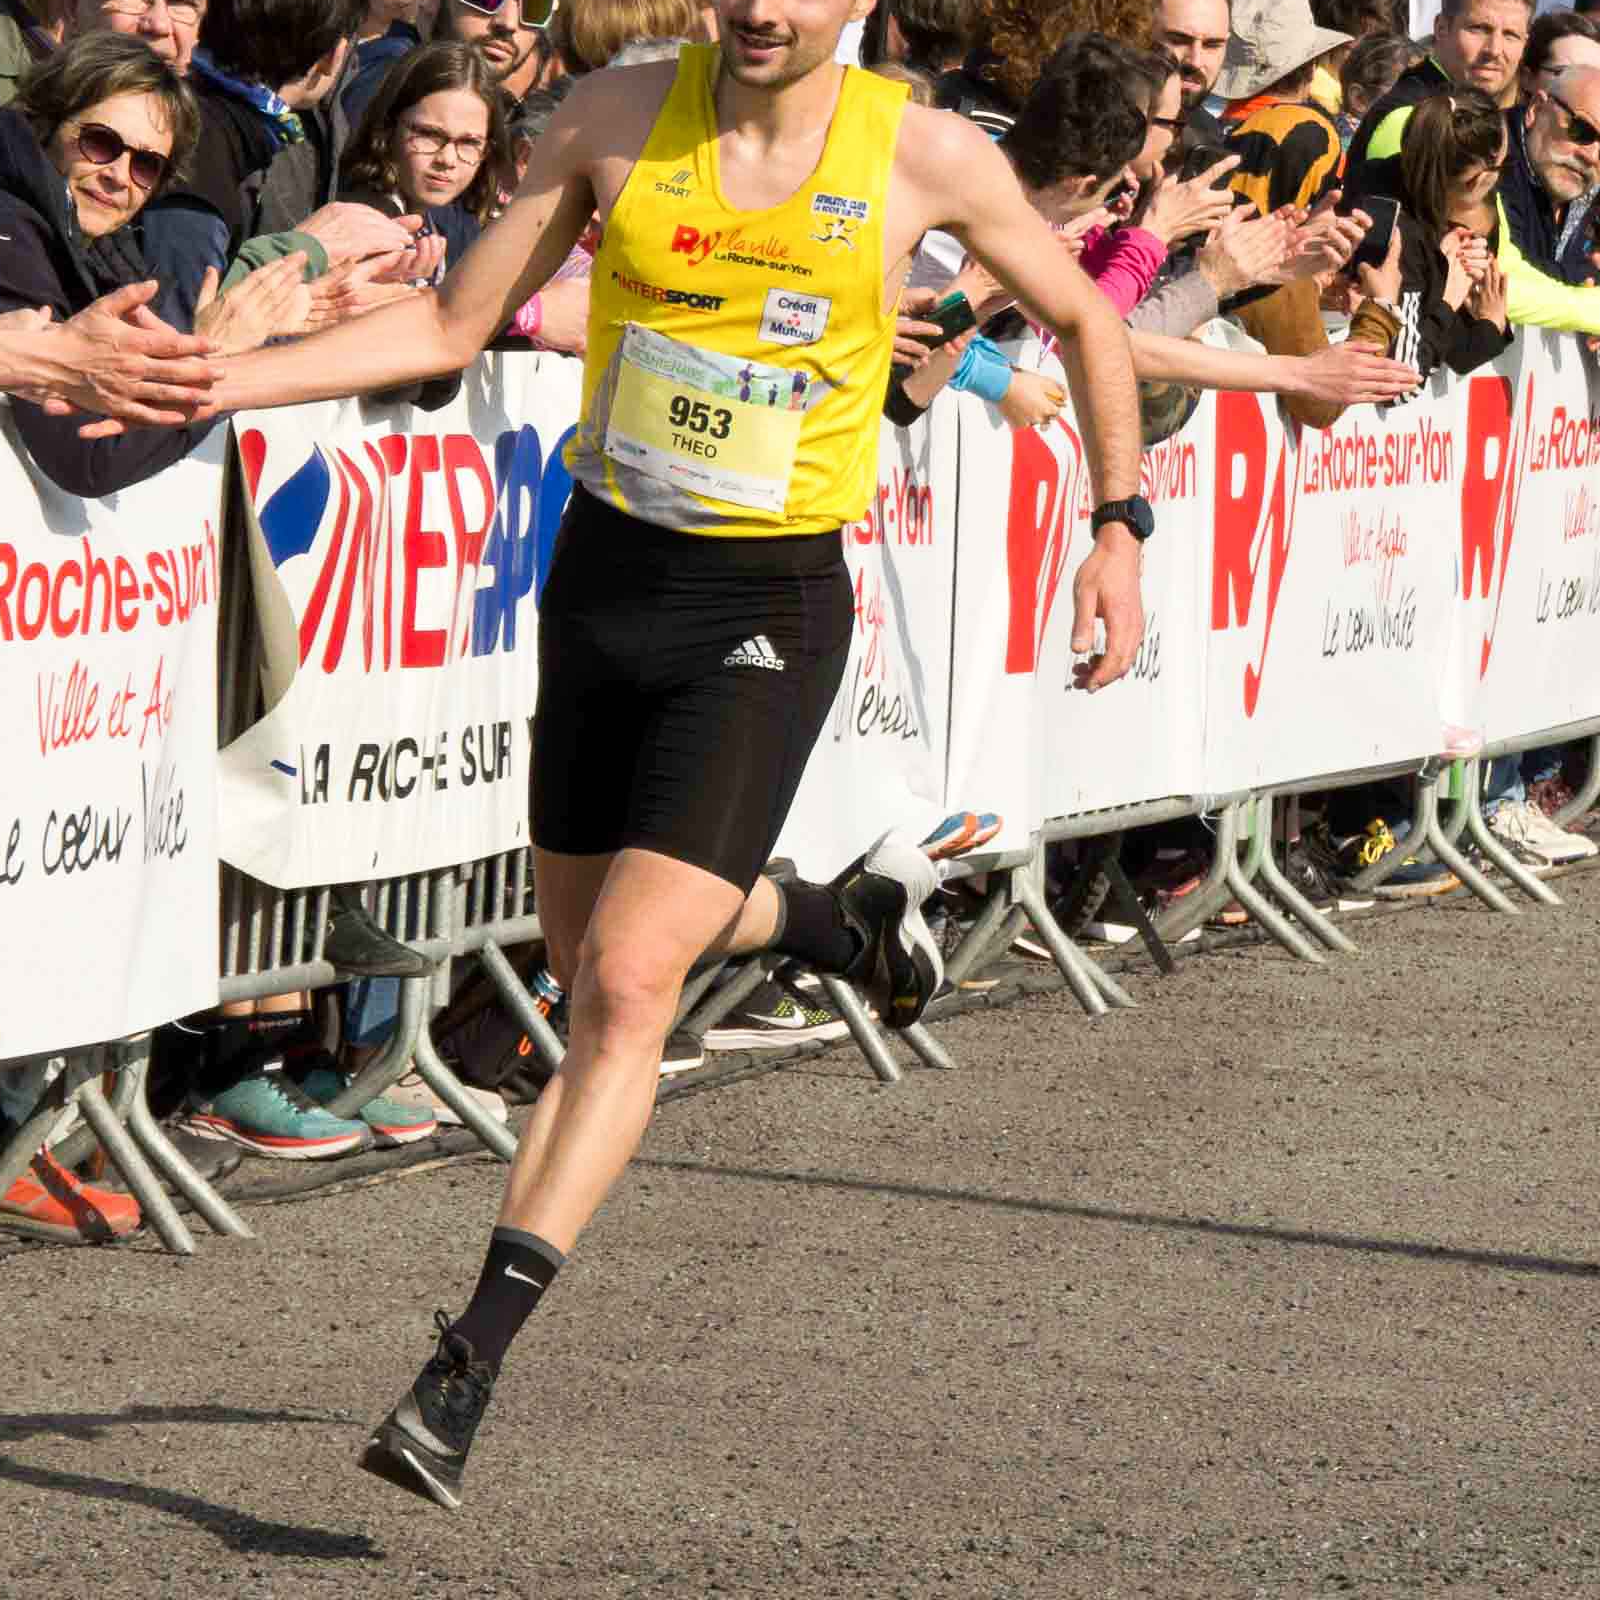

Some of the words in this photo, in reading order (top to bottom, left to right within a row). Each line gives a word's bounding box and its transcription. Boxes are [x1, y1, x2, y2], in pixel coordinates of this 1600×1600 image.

[655, 182, 692, 199] START
[778, 297, 817, 315] Crédit
[769, 321, 816, 341] Mutuel
[668, 395, 734, 440] 953
[672, 432, 719, 459] THEO
[1303, 444, 1321, 494] La
[1320, 416, 1456, 493] Roche-sur-Yon
[1321, 599, 1340, 658] Le
[723, 653, 786, 673] adidas
[37, 657, 100, 758] Ville
[108, 671, 137, 740] et
[460, 720, 513, 788] SUR
